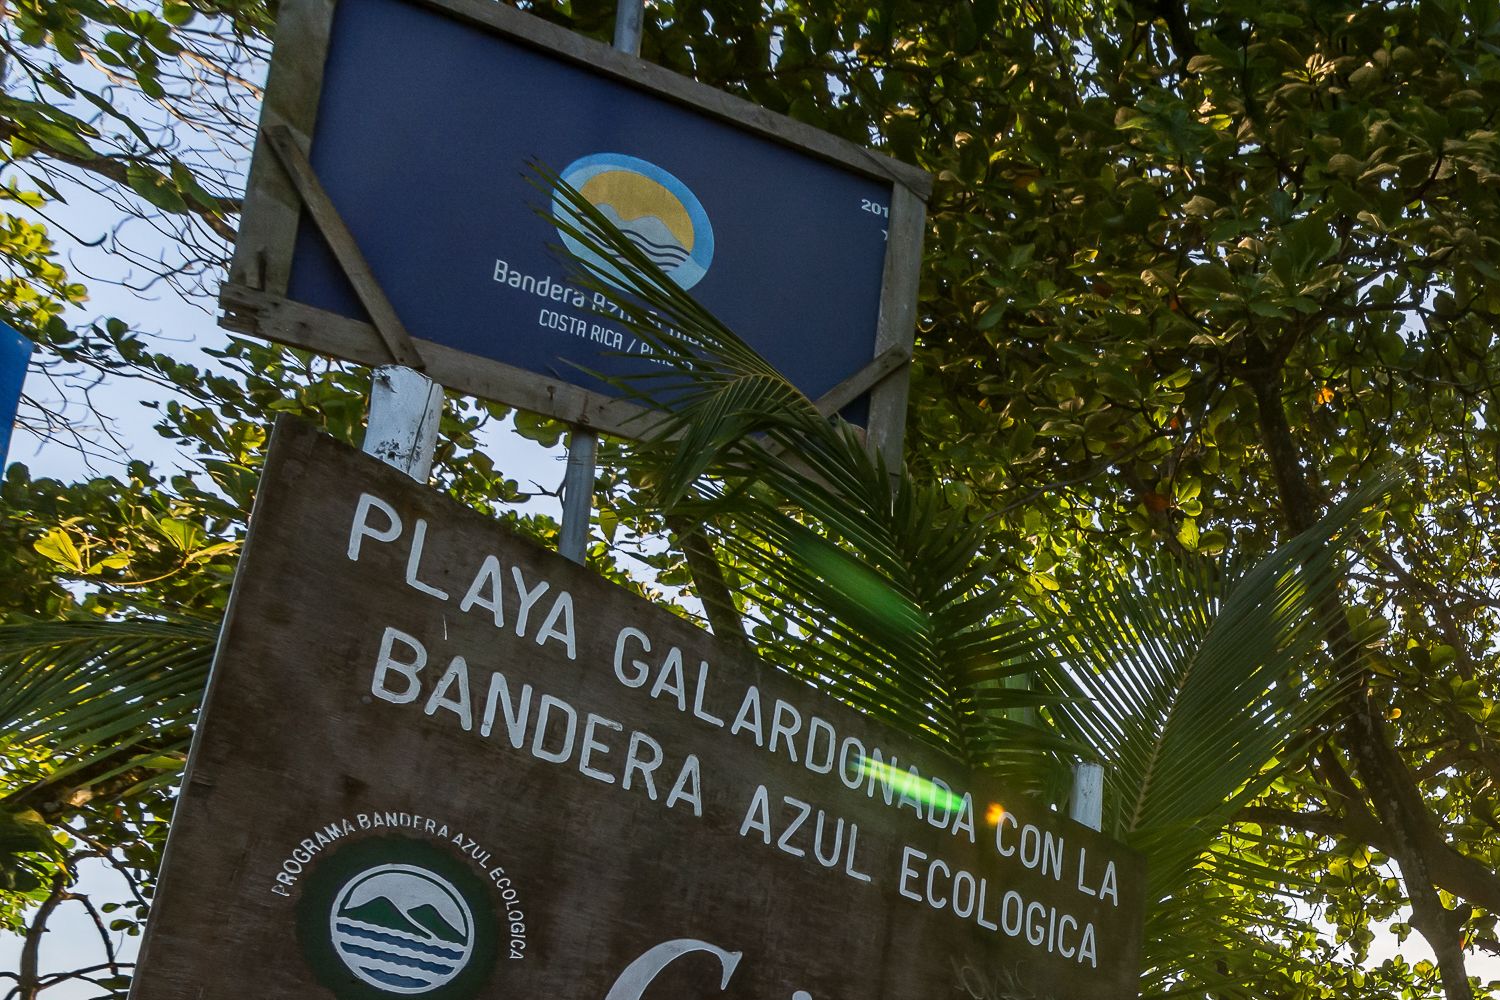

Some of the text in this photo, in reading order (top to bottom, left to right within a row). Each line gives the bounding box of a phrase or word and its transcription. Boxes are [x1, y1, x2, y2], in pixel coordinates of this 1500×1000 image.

[493, 258, 585, 308] Bandera
[538, 309, 587, 338] COSTA
[590, 324, 623, 350] RICA
[347, 492, 1119, 907] PLAYA GALARDONADA CON LA
[371, 626, 1098, 968] BANDERA AZUL ECOLOGICA
[271, 811, 527, 961] PROGRAMA BANDERA AZUL ECOLOGICA
